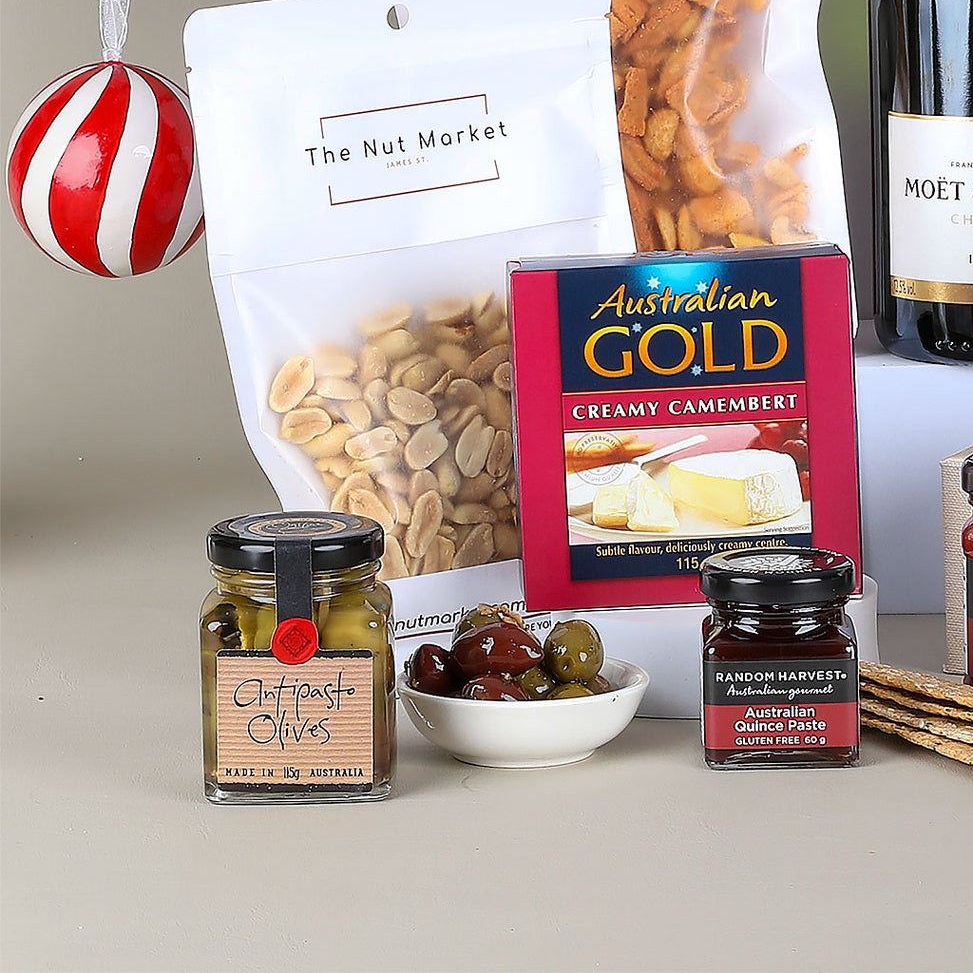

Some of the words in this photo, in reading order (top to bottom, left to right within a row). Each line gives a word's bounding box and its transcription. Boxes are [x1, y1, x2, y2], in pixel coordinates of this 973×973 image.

[305, 146, 351, 166] The
[363, 136, 406, 158] Nut
[418, 121, 508, 150] Market
[386, 158, 412, 169] JAMES
[904, 176, 965, 201] MOËT
[590, 278, 777, 320] Australian
[583, 319, 788, 378] GOLD
[572, 401, 659, 420] CREAMY
[668, 394, 798, 415] CAMEMBERT
[596, 545, 626, 557] Subtle
[628, 543, 663, 556] flavour,
[666, 540, 716, 554] deliciously
[716, 672, 774, 683] RANDOM
[727, 684, 788, 696] Australian
[744, 706, 816, 719] Australian
[248, 710, 331, 750] Olives
[734, 720, 784, 732] Quince
[788, 720, 827, 731] Paste
[735, 736, 773, 746] GLUTEN
[776, 736, 800, 744] FREE
[225, 768, 255, 777] MADE
[262, 768, 274, 777] IN
[284, 766, 300, 780] 115g
[310, 768, 364, 777] AUSTRALIA
